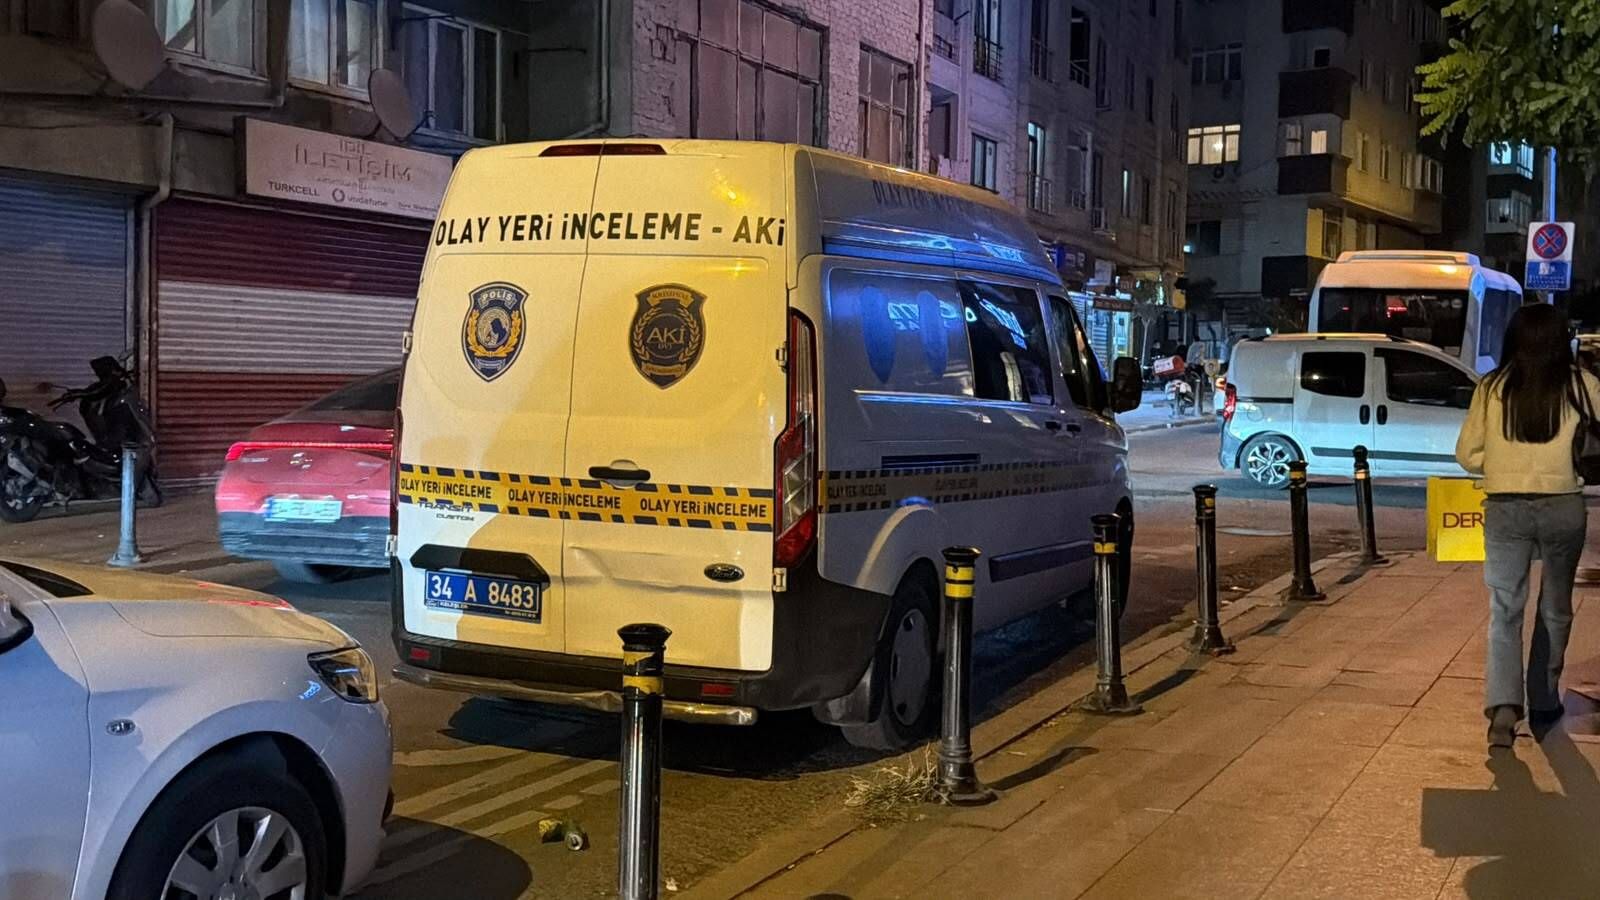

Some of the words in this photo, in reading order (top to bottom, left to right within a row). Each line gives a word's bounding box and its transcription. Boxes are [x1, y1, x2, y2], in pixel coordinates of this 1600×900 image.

[268, 181, 321, 197] TURKCELL
[435, 217, 490, 246] OLAY
[401, 478, 420, 492] OLAY
[508, 489, 535, 502] OLAY
[417, 500, 474, 512] TRANSIT
[640, 498, 671, 512] OLAY
[436, 513, 474, 521] CUSTOM
[431, 575, 452, 600] 34
[464, 579, 477, 602] A
[488, 581, 534, 609] 8483
